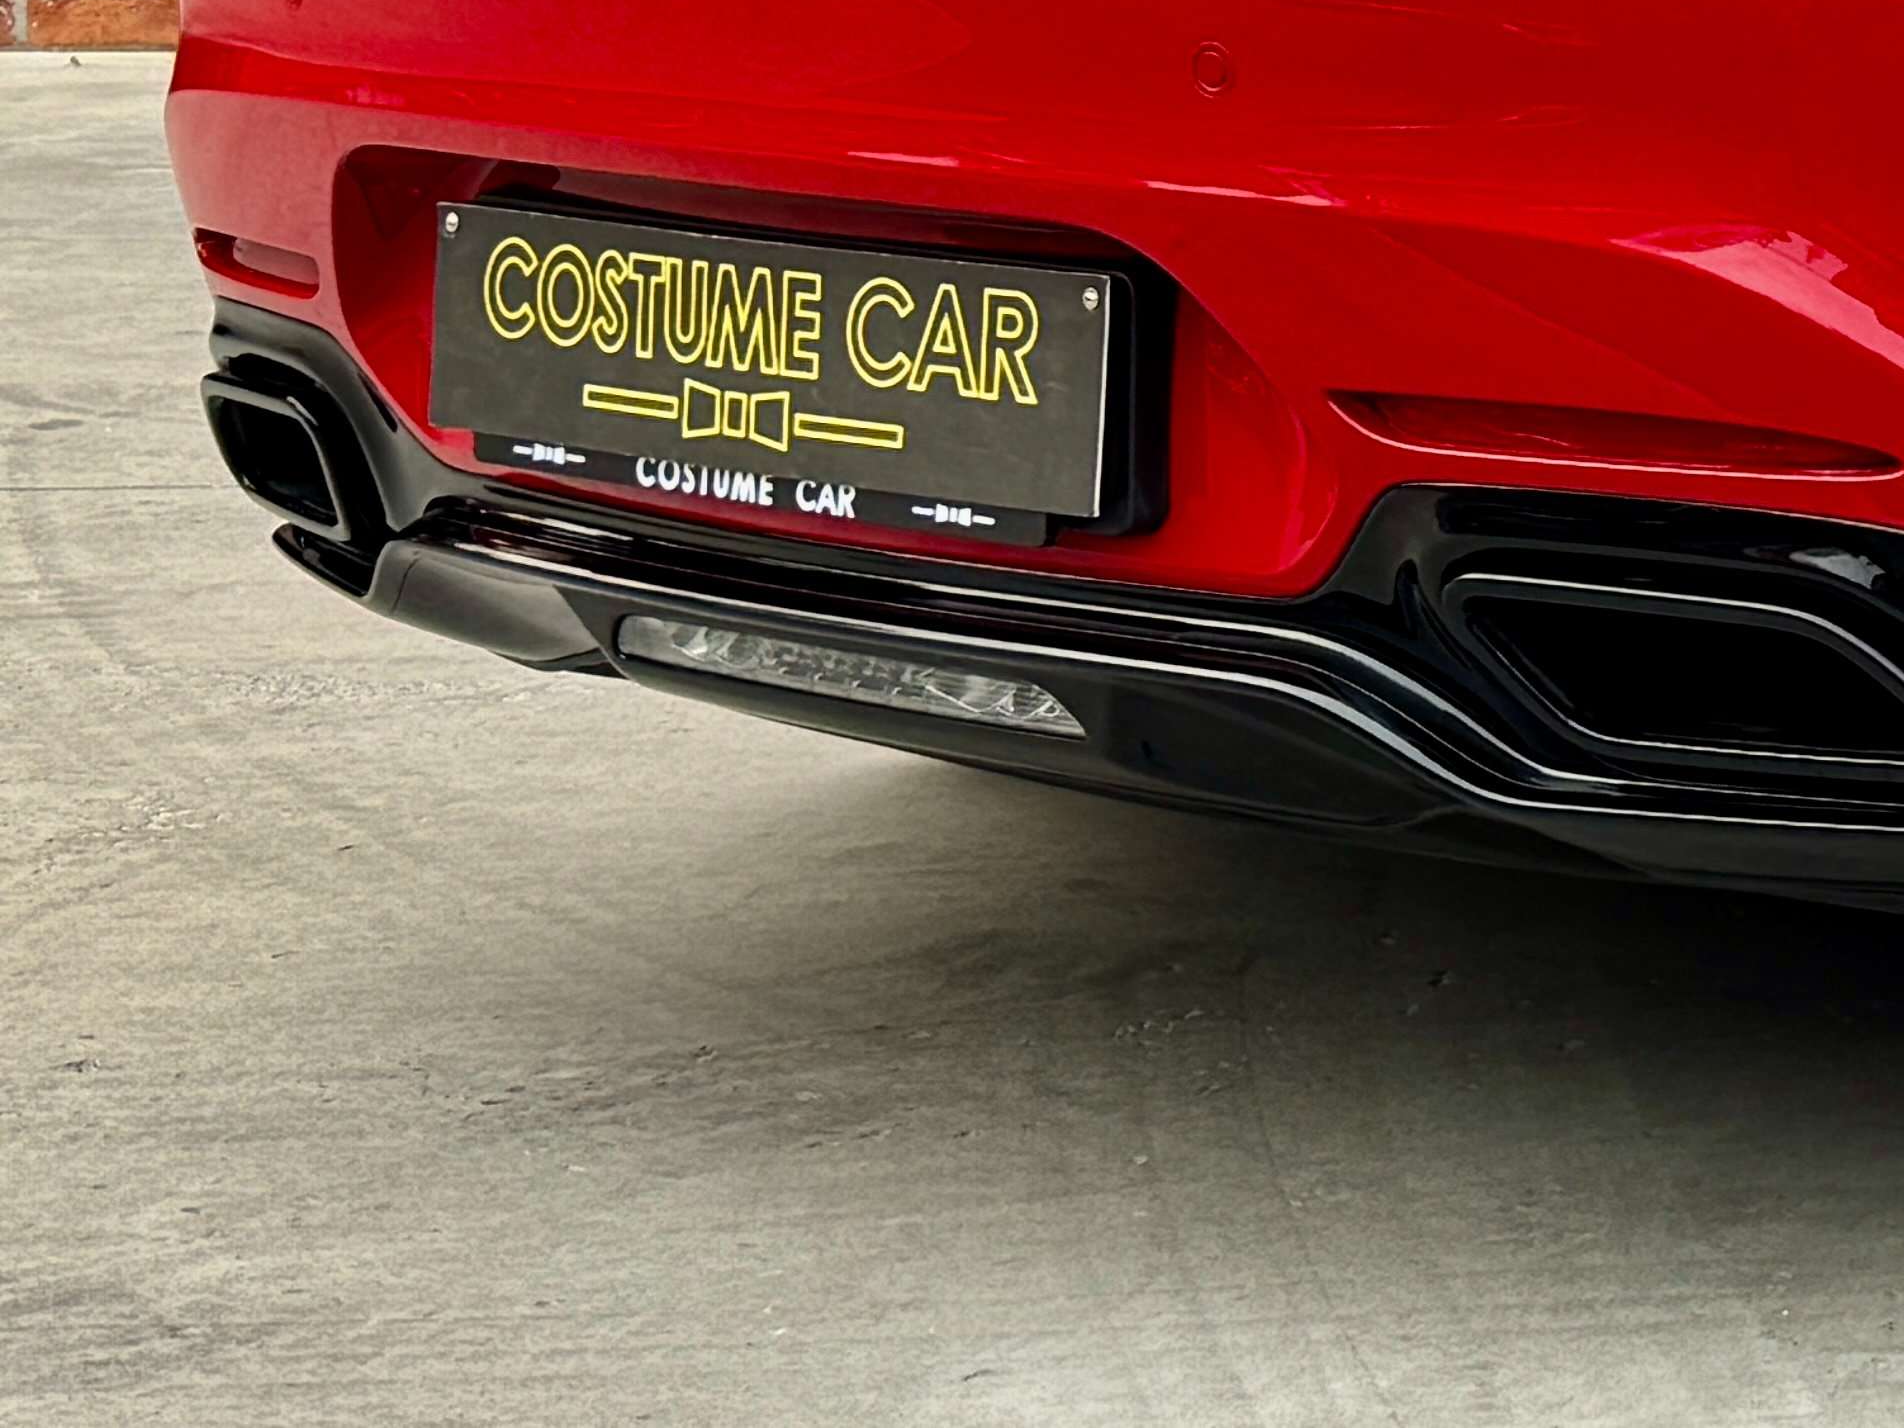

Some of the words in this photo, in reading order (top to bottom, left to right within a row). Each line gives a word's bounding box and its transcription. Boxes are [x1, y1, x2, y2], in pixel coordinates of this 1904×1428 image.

[484, 236, 822, 380] COSTUME
[846, 276, 1039, 405] CAR
[635, 457, 774, 507] COSTUME
[795, 479, 857, 519] CAR
